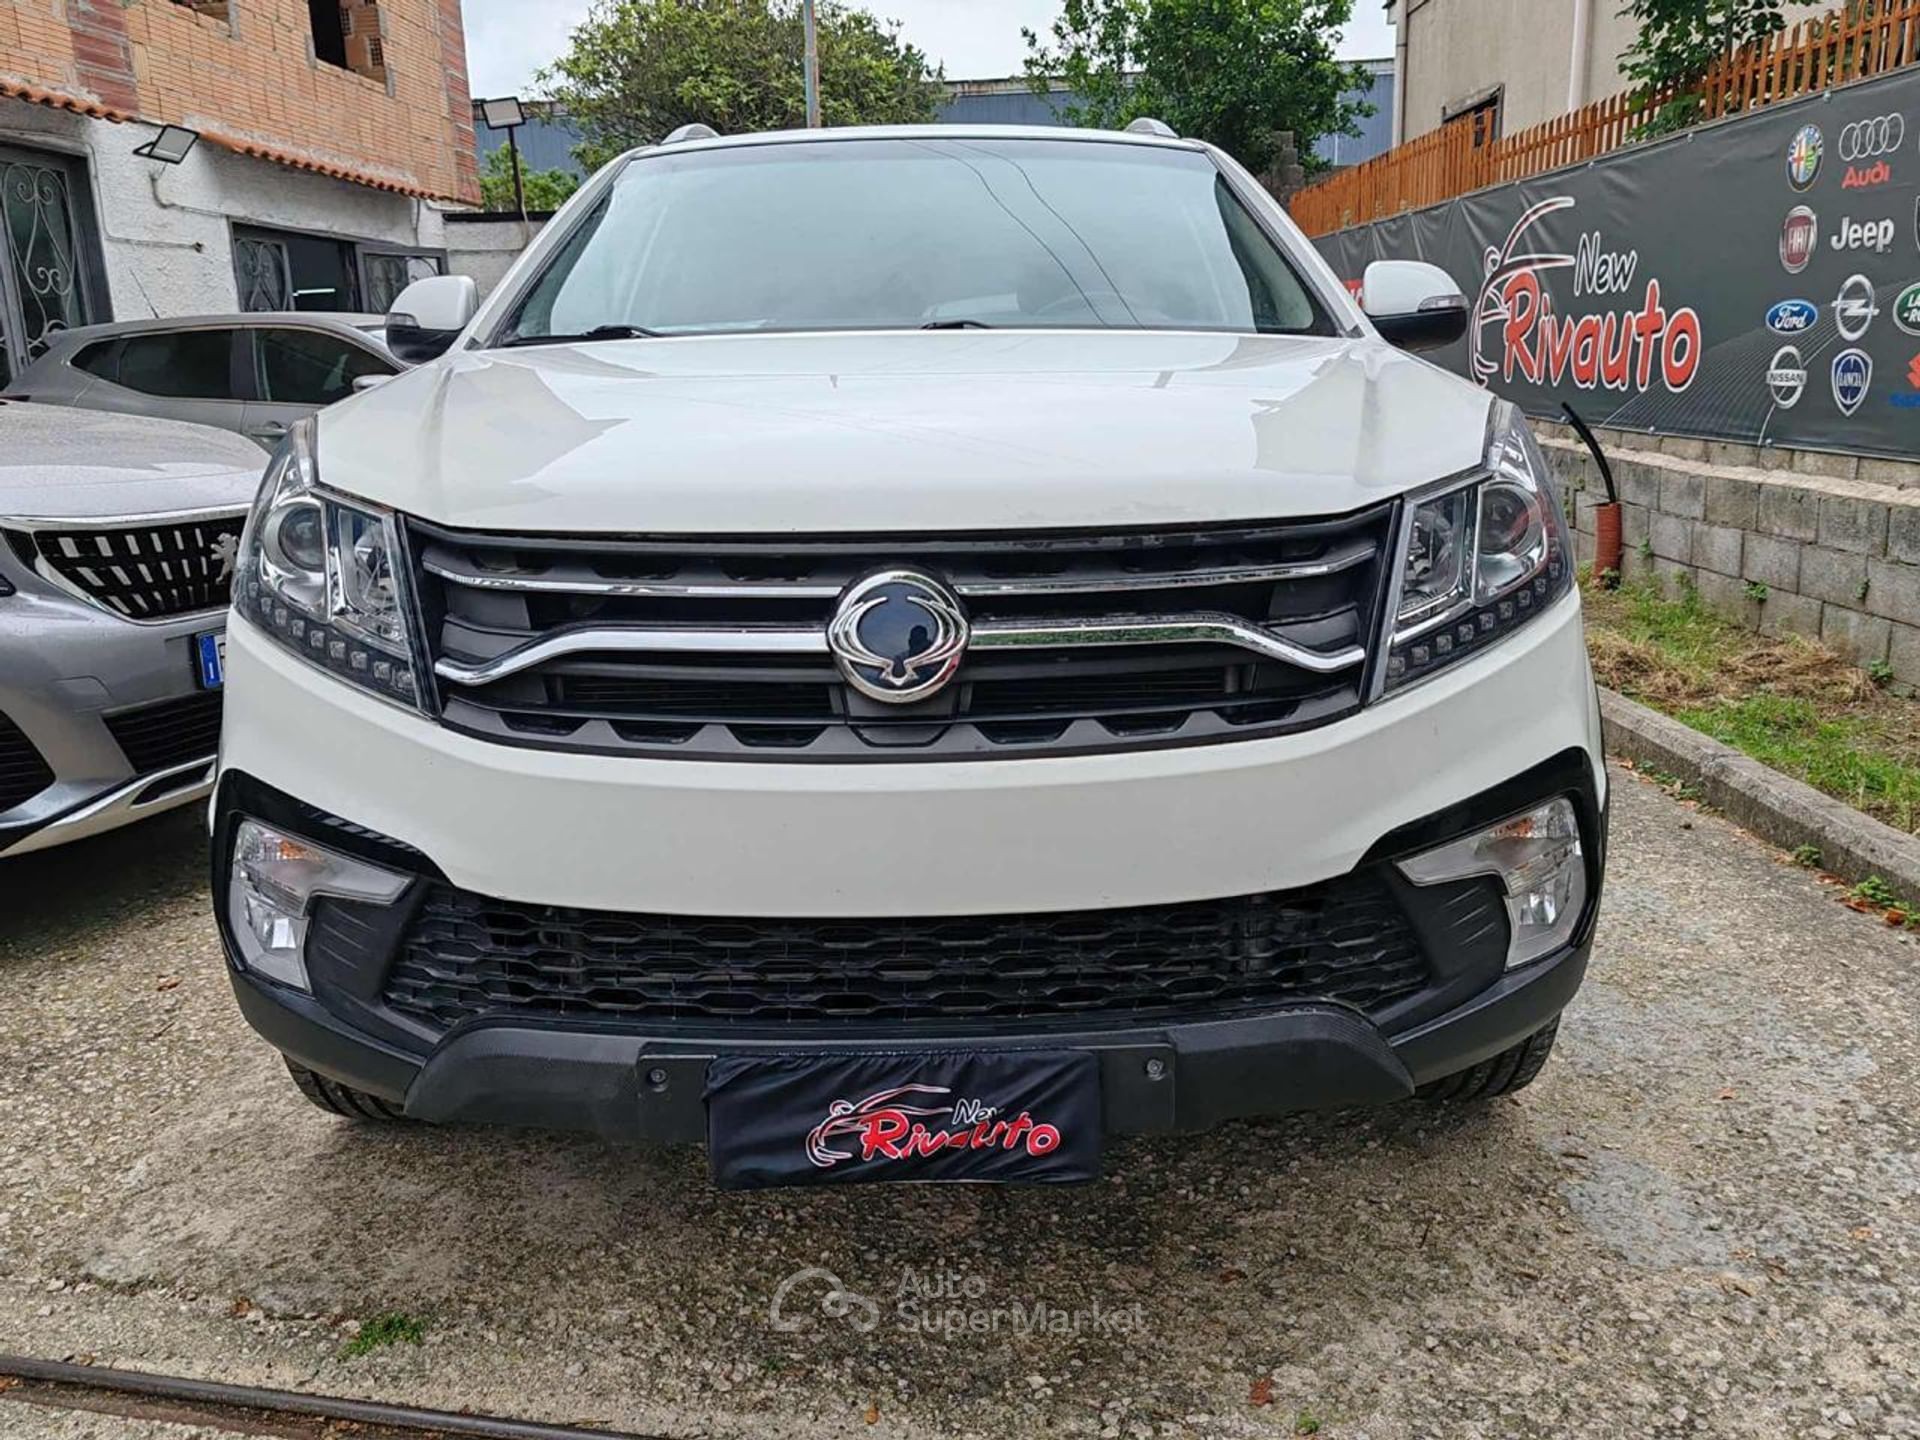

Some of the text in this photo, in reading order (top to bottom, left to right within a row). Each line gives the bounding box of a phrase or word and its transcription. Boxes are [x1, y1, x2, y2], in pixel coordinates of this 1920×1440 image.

[1841, 160, 1892, 189] Audi
[1831, 216, 1895, 253] Jeep
[1573, 231, 1637, 297] New
[1502, 268, 1701, 392] Rivauto
[1774, 304, 1808, 330] Ford
[1769, 371, 1804, 384] NISSAN
